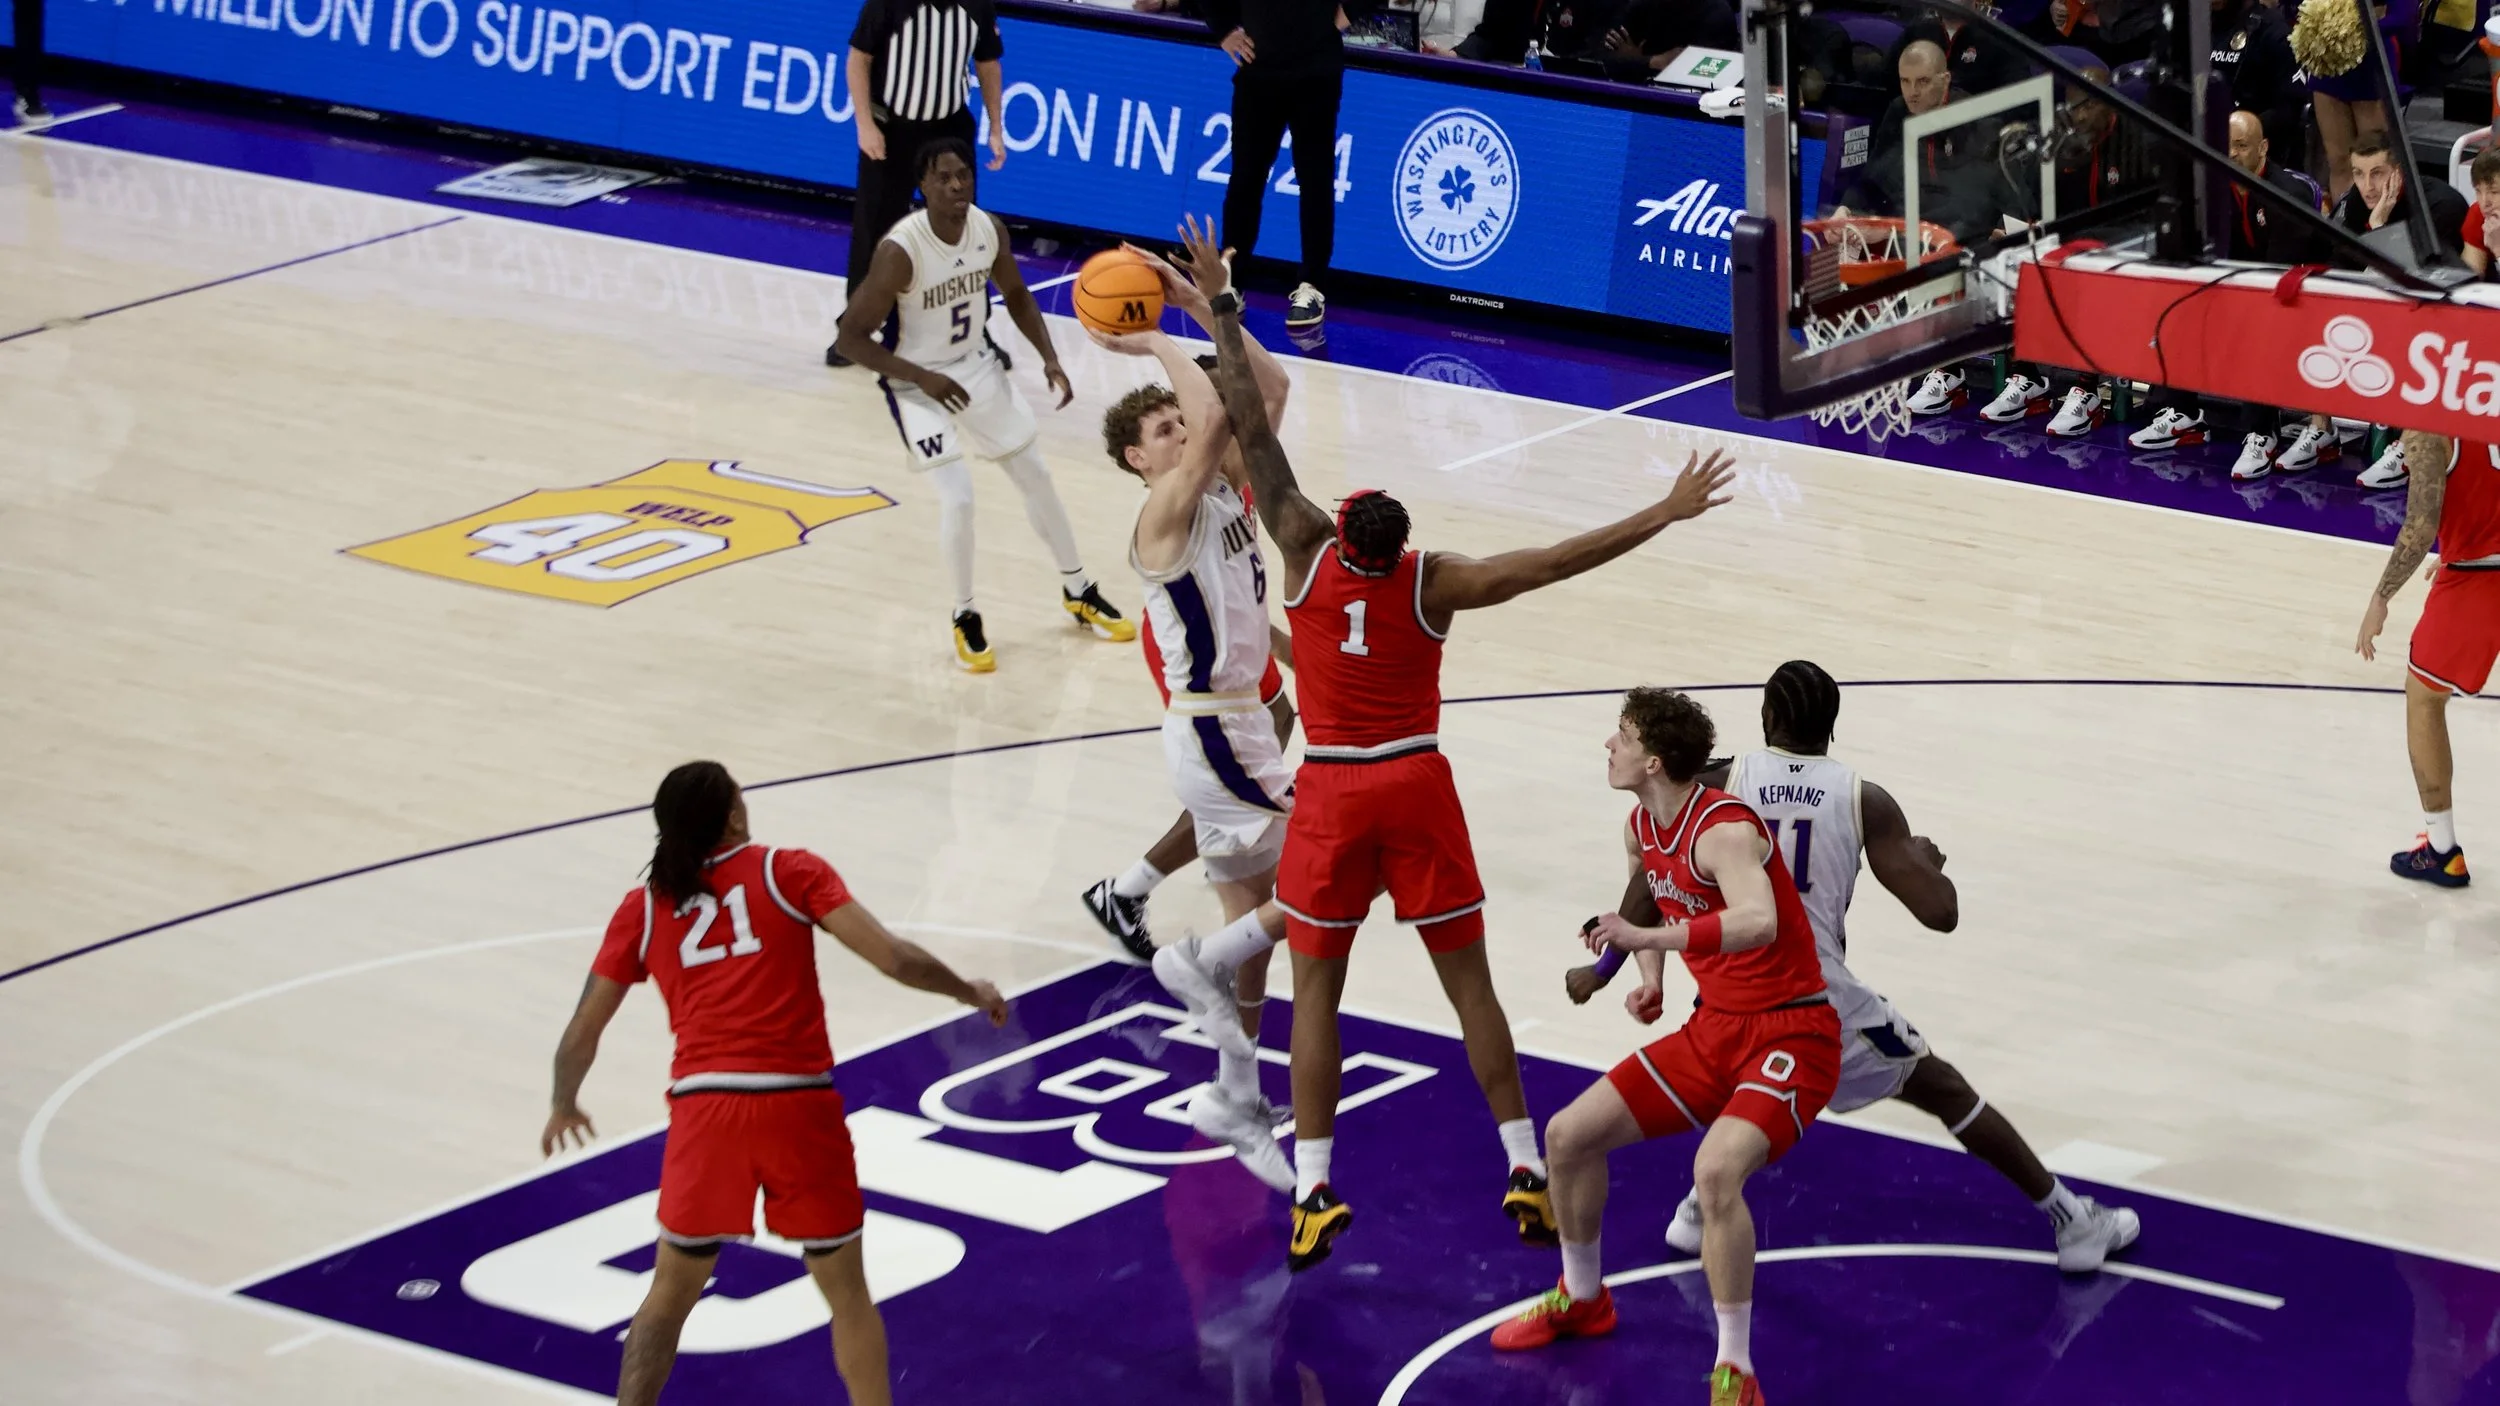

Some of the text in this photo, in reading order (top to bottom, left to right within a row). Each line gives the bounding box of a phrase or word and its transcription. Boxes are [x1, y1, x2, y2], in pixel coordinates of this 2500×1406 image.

[2210, 50, 2241, 63] POLICE
[472, 0, 733, 102] SUPPORT
[1115, 98, 1182, 175] IN
[1197, 112, 1353, 203] 224
[1406, 124, 1507, 220] WASHINGTON'S
[1425, 207, 1500, 254] LOTTERY
[923, 267, 990, 310] HUSKIE
[1449, 293, 1504, 309] DAKTRONICS
[950, 301, 971, 346] 5
[2400, 331, 2500, 418] Sta
[917, 432, 943, 458] W
[624, 501, 735, 527] WELP
[466, 511, 729, 582] 40
[1340, 599, 1370, 657] 1
[1788, 763, 1805, 773] W
[1759, 785, 1825, 807] KEPNANG
[1764, 819, 1814, 893] 1
[673, 883, 763, 970] 21
